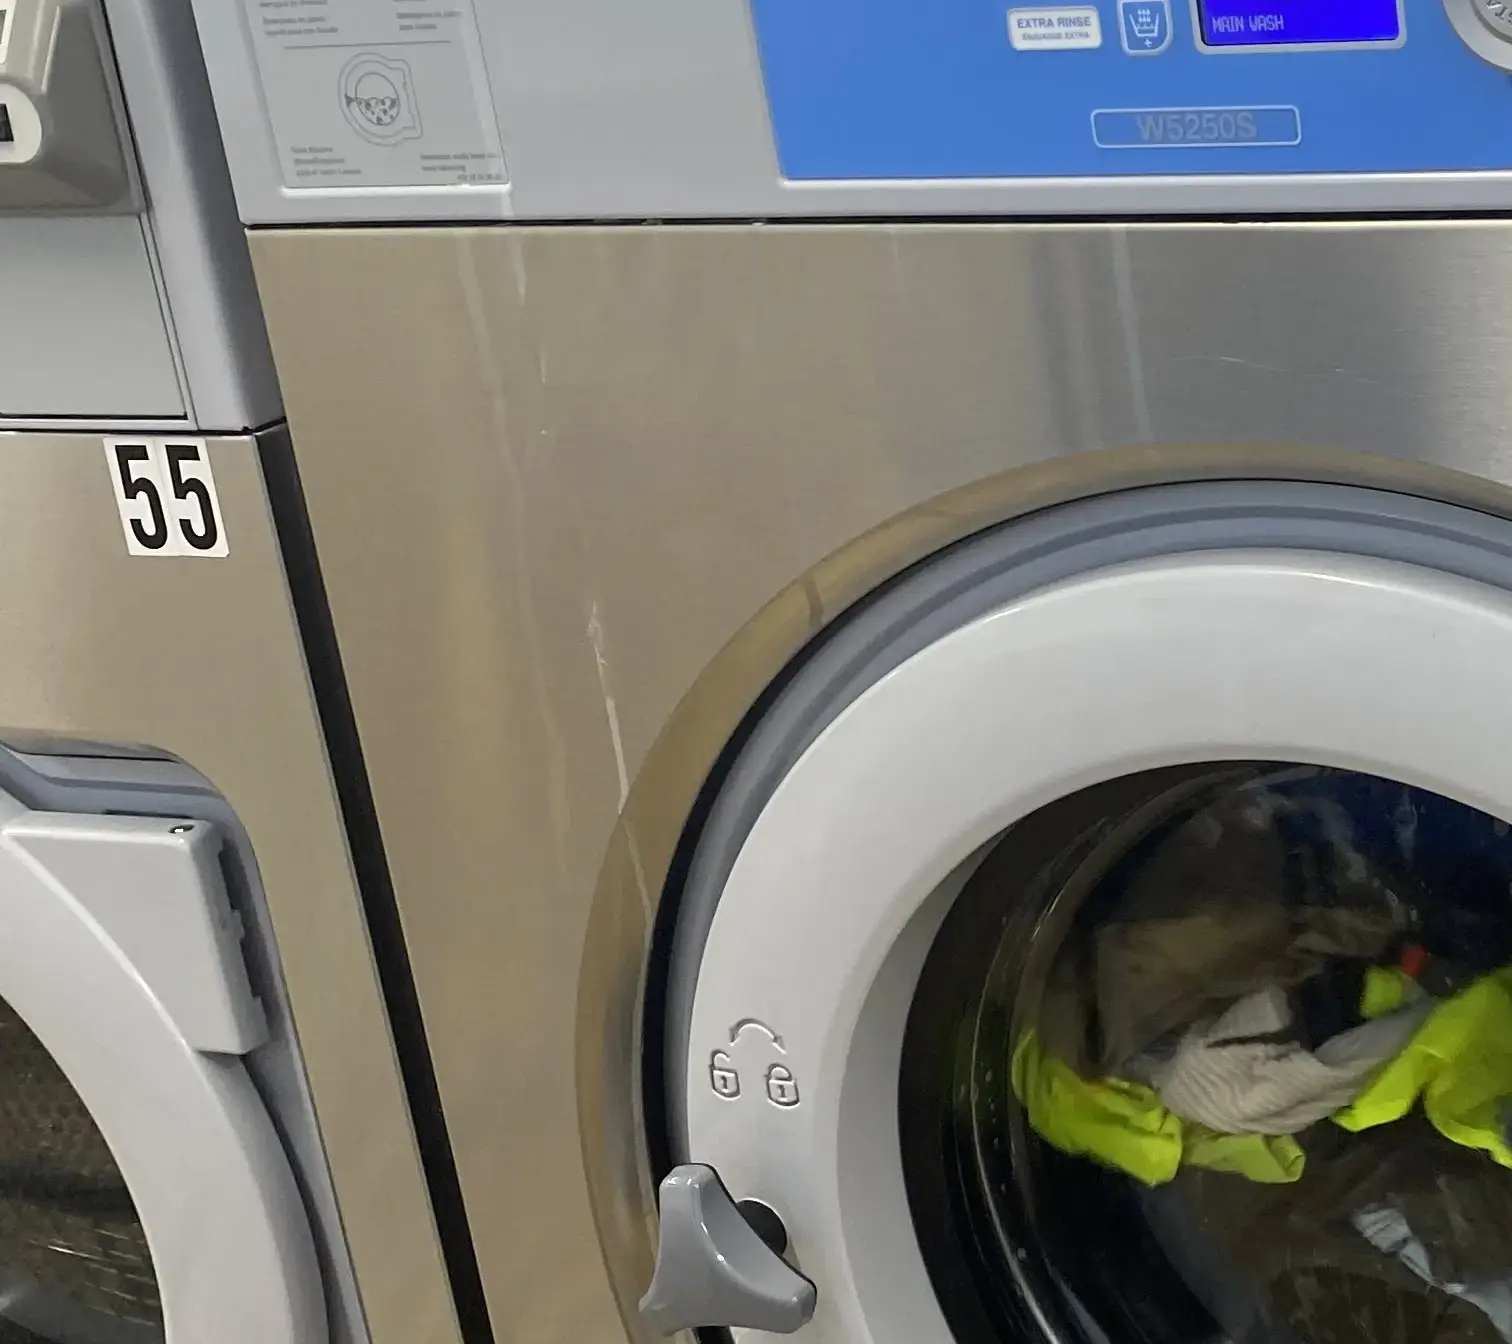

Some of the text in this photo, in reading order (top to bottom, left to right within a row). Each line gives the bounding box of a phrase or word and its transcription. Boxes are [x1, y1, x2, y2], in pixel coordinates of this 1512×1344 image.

[1017, 16, 1092, 29] EXTRA RINSE
[1211, 14, 1285, 33] MAIN WASH
[1136, 112, 1257, 141] W5250S
[113, 444, 218, 550] 55
